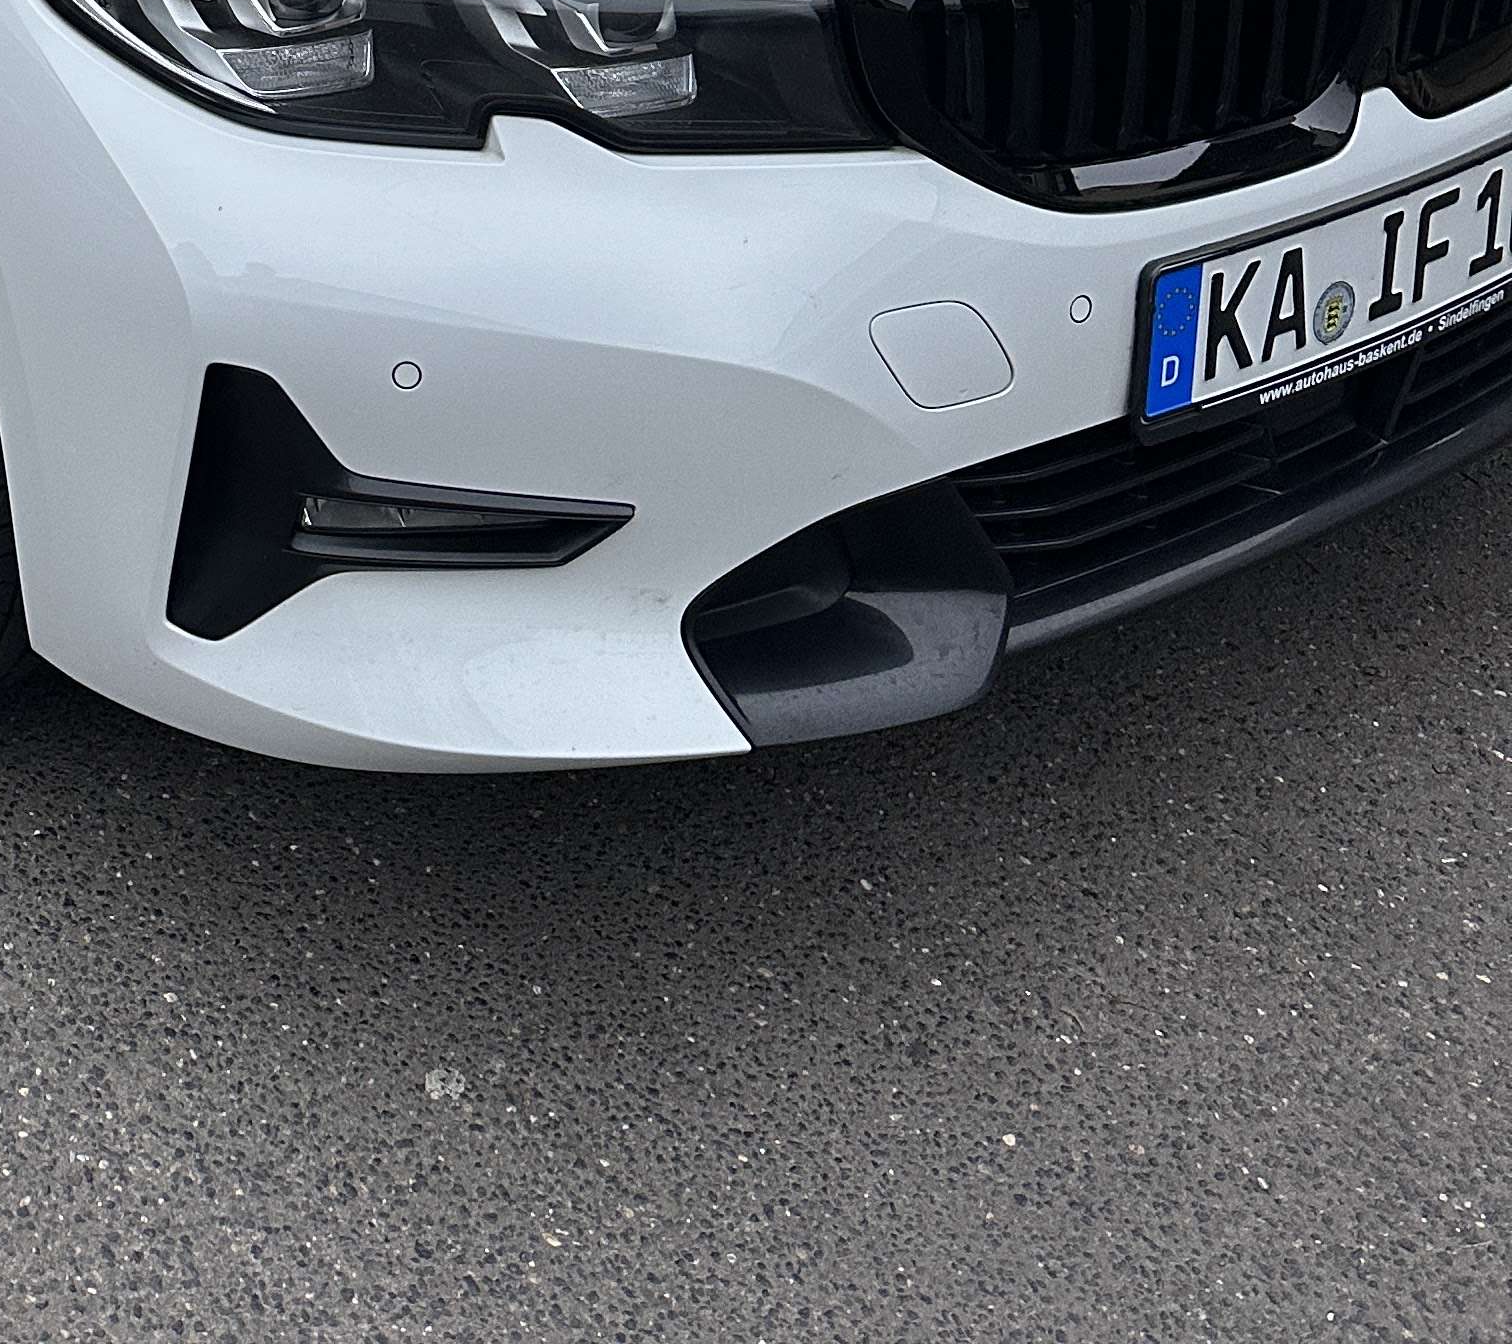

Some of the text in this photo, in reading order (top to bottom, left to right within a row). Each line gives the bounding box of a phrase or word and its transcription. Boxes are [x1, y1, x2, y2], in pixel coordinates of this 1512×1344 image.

[1160, 355, 1180, 387] D
[1203, 247, 1308, 382] KA
[1258, 288, 1505, 405] www.autohaus-baskent.de Sindelfingen
